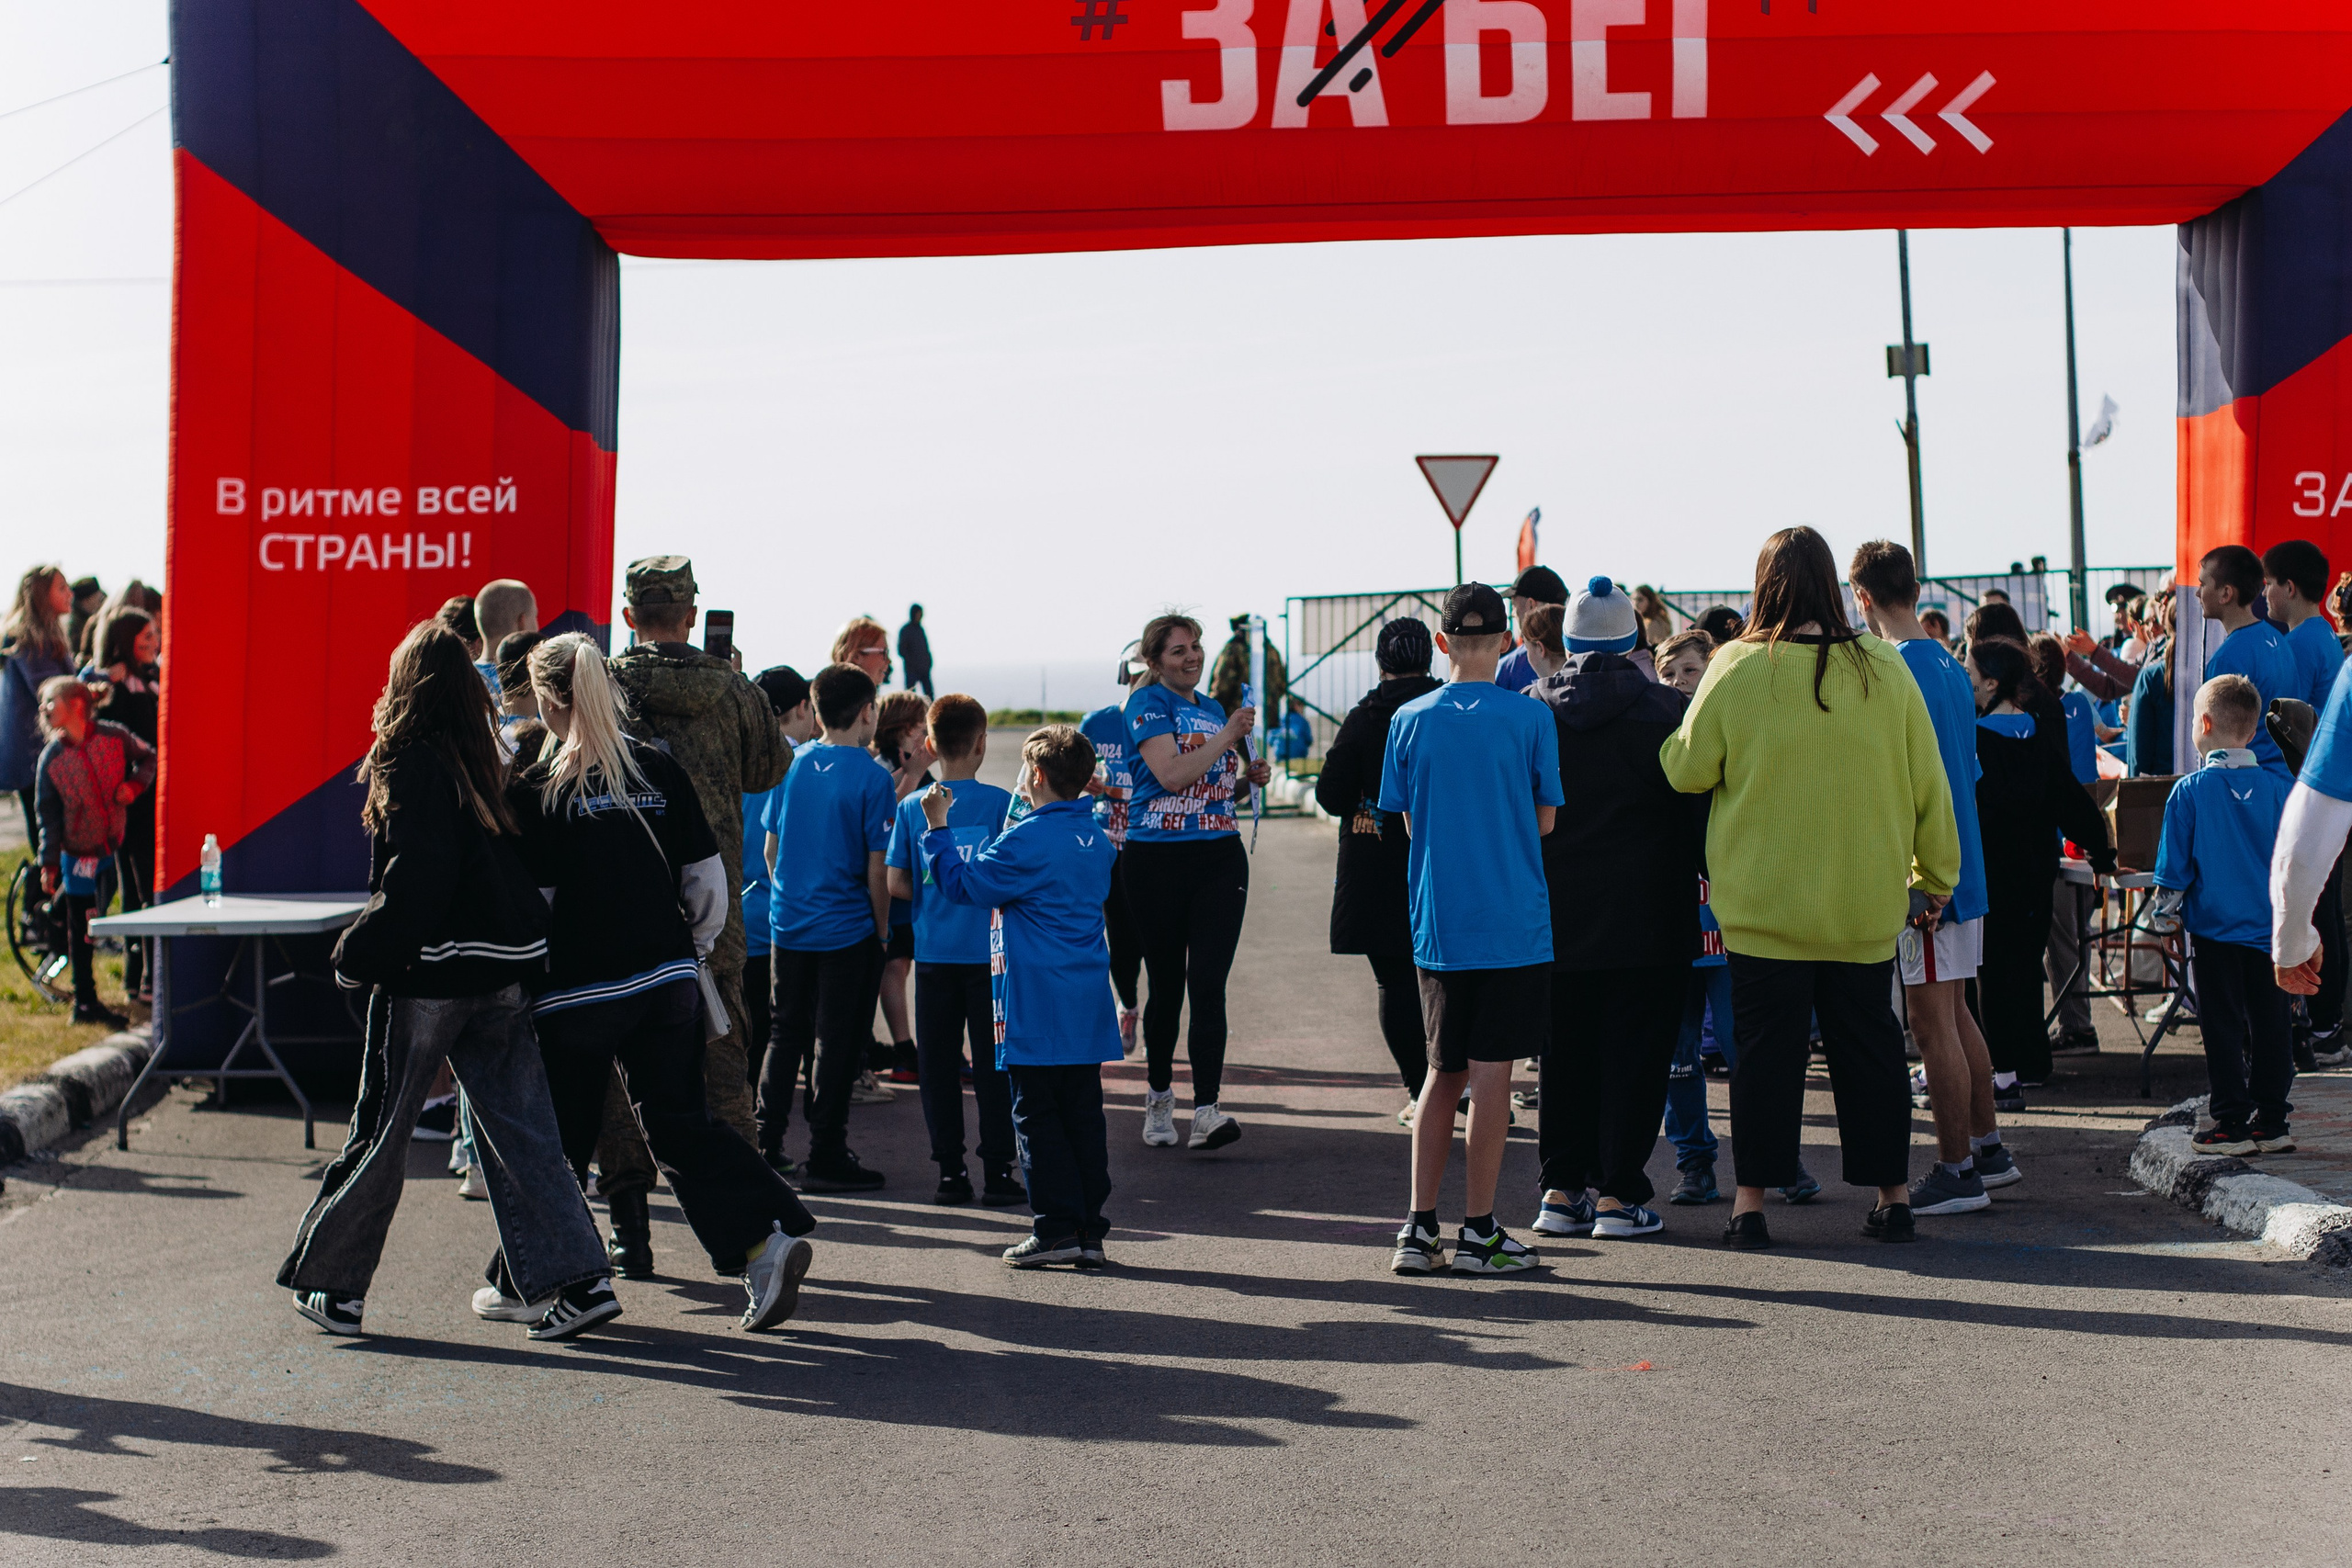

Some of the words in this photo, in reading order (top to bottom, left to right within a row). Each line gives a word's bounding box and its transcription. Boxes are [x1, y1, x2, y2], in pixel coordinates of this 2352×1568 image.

[217, 477, 246, 515] В
[261, 486, 402, 522] ритме
[416, 476, 517, 515] всей
[259, 531, 471, 571] СТРАНЫ!
